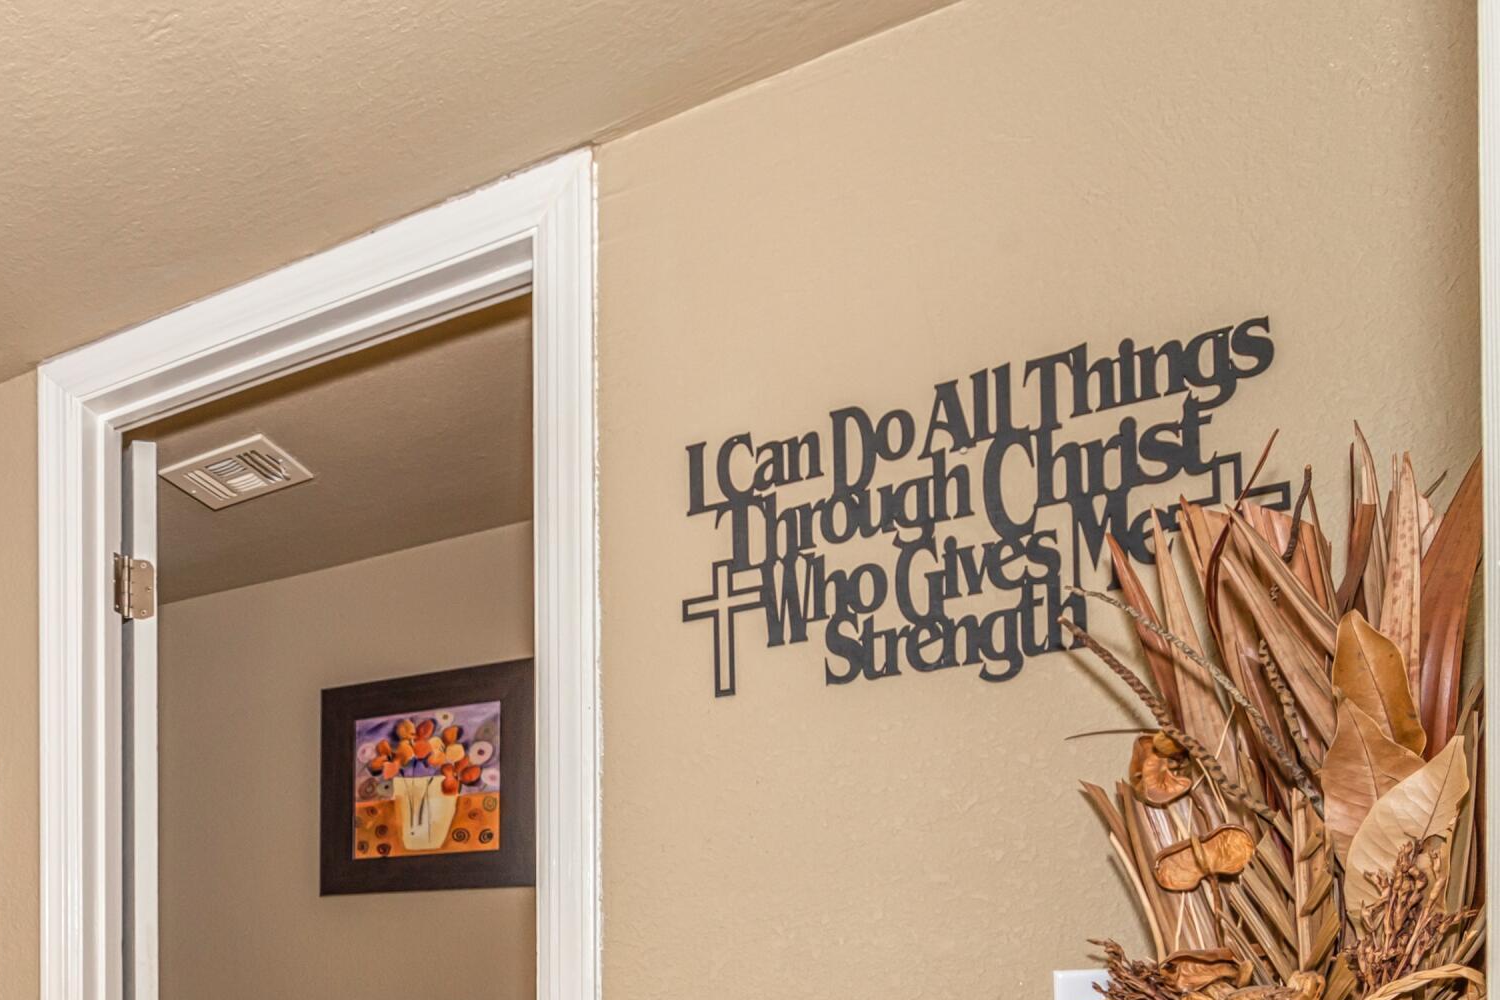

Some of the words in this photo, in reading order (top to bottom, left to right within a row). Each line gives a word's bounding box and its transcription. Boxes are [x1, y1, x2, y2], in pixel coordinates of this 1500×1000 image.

[686, 441, 713, 516] I
[717, 431, 824, 498] Can
[830, 407, 915, 498] Do
[918, 362, 1029, 460] All
[1023, 316, 1275, 431] Things
[715, 463, 974, 572] Through
[983, 390, 1216, 541] Christ
[761, 552, 888, 648] Who
[894, 528, 1061, 626] Gives
[825, 576, 1087, 686] Strength
